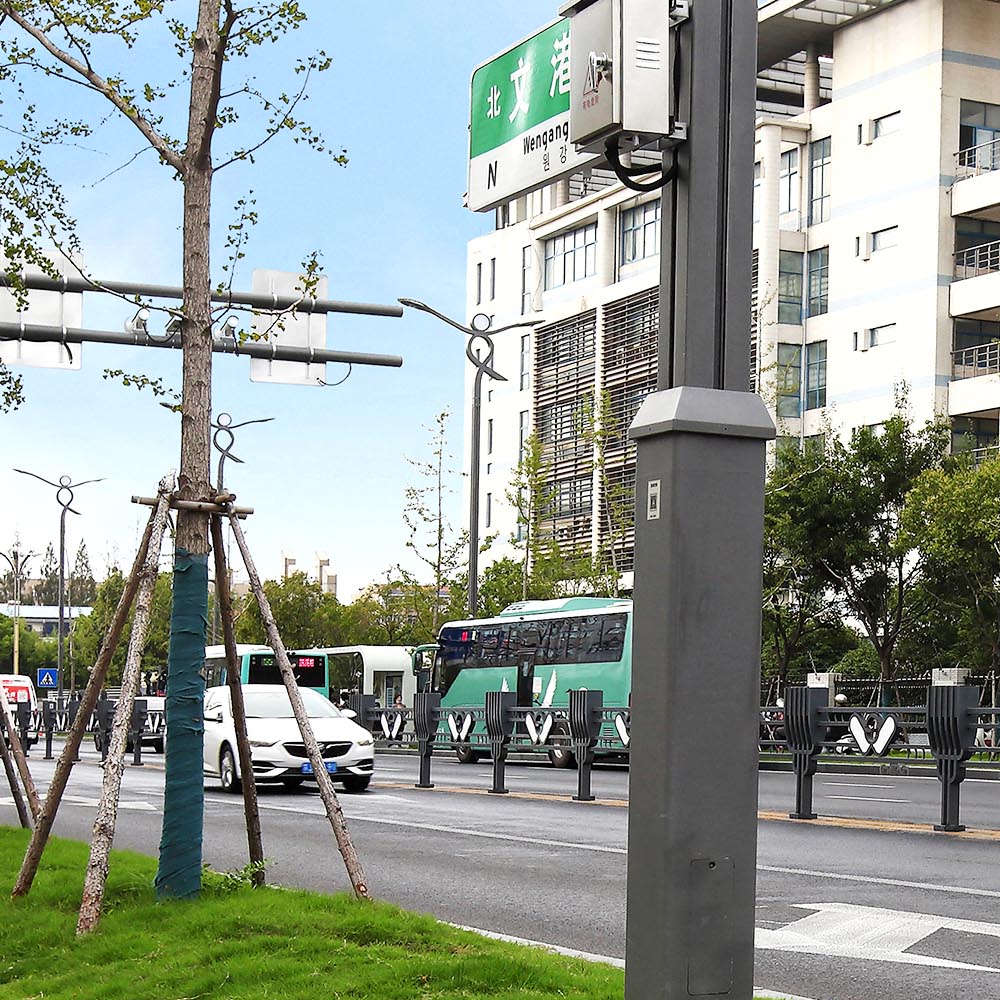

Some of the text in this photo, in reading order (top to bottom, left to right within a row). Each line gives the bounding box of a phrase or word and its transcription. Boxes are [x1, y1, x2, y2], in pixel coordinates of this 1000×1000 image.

[487, 84, 501, 119] 北
[523, 120, 569, 155] Wengang
[487, 160, 498, 190] N
